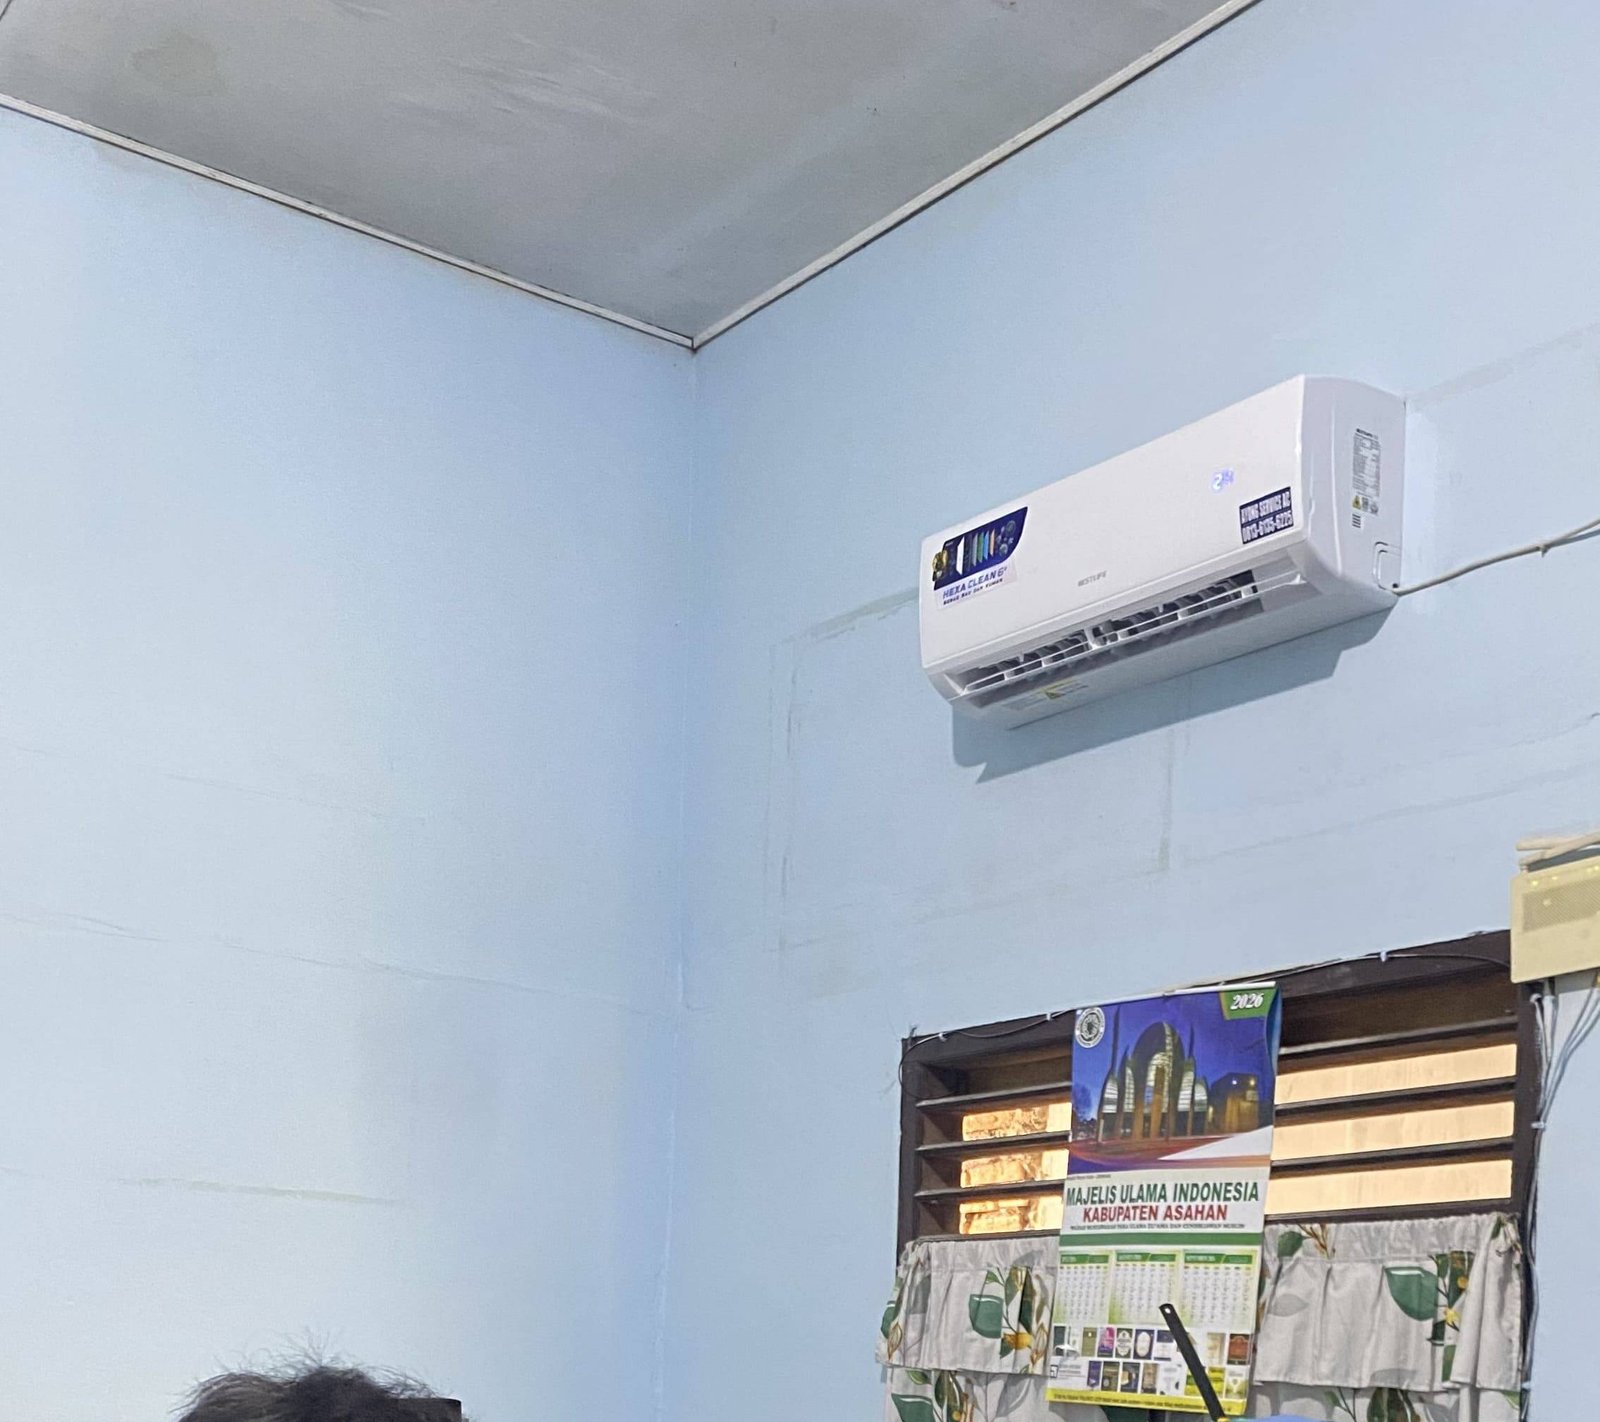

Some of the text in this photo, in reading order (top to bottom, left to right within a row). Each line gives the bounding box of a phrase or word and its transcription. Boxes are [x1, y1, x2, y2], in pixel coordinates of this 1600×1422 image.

[942, 583, 967, 600] HEXA
[967, 570, 997, 589] CLEAN
[1230, 992, 1264, 1010] 2026
[1066, 1181, 1260, 1206] MAJELIS ULAMA INDONESIA
[1083, 1204, 1228, 1223] KABUPATEN ASAHAN
